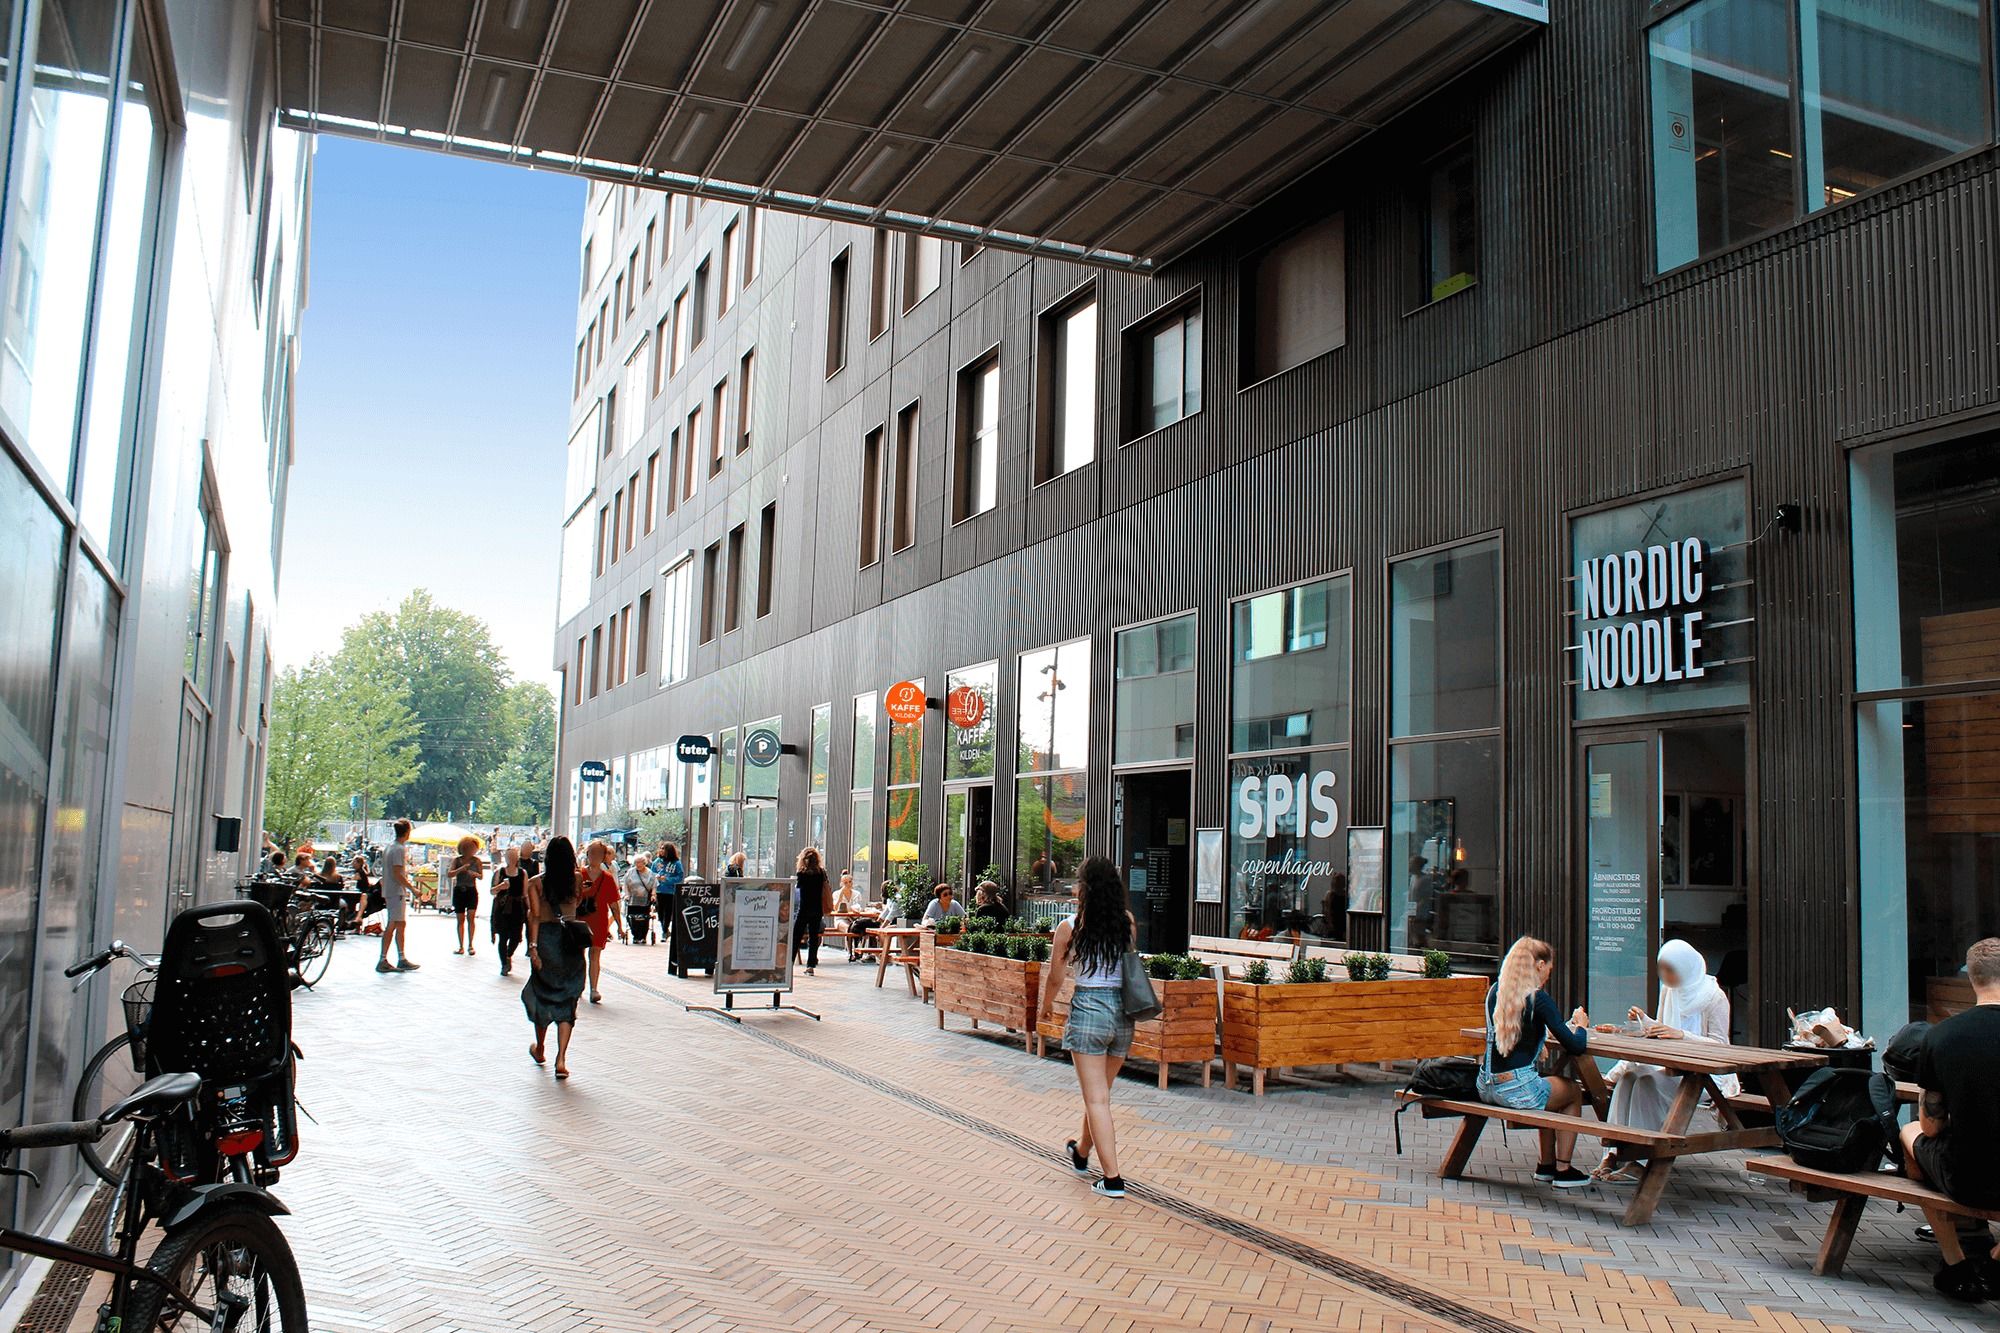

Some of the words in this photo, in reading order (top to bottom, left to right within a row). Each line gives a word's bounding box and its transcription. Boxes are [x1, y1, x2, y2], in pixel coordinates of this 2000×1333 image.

[1582, 537, 1703, 620] NORDIC
[1582, 611, 1704, 691] NOODLE
[891, 703, 920, 712] KAFFE
[957, 728, 984, 745] KAFFE
[960, 749, 979, 760] KILDEN
[1239, 770, 1338, 839] SPIS
[1241, 848, 1333, 890] copenhagen
[1593, 873, 1641, 881] ÅBNINGSTIDER
[681, 885, 712, 897] FILTER
[699, 897, 720, 905] KAFFE
[1592, 907, 1641, 915] FROKOSTTILBUD
